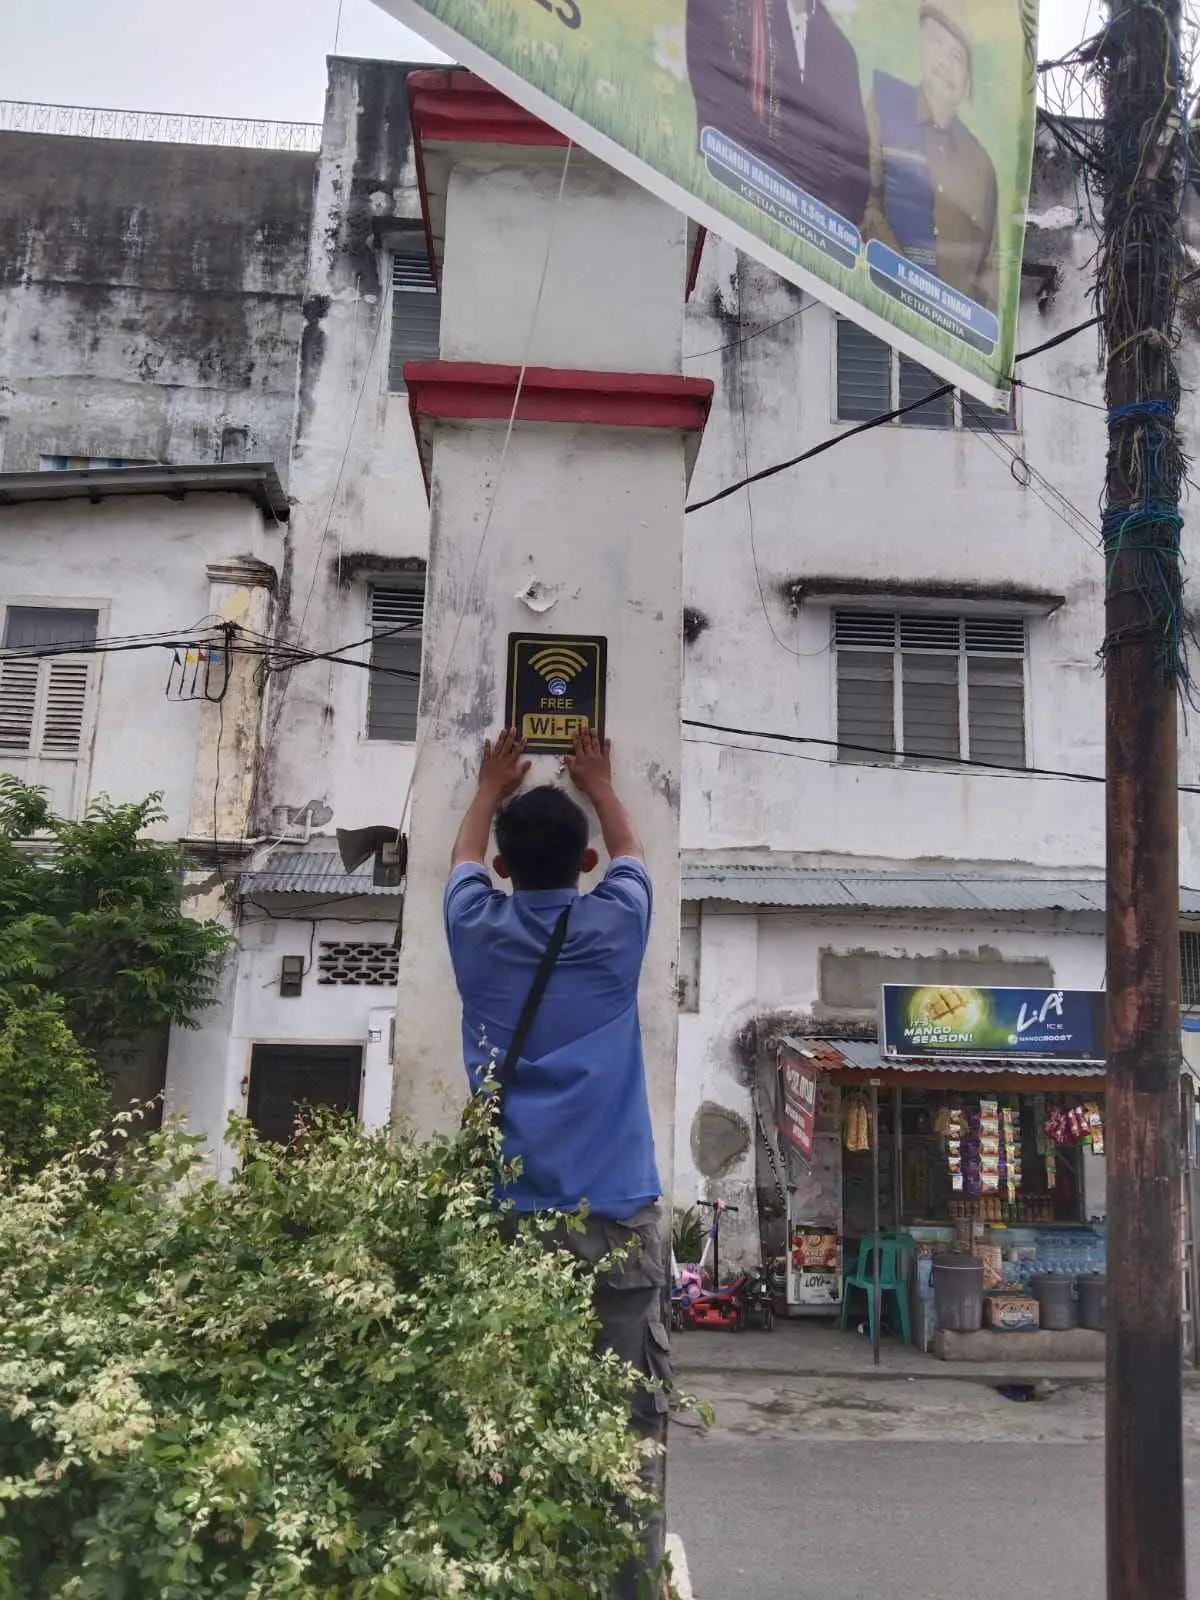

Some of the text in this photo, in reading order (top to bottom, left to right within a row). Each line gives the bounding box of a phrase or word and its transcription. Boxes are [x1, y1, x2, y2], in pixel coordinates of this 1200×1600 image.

[740, 183, 777, 216] KETUA
[901, 288, 967, 339] KETUA PANITIA
[540, 697, 574, 710] FREE
[528, 716, 585, 736] Wi-Fi
[904, 1026, 952, 1037] MANGO
[911, 1032, 974, 1045] SEASON!
